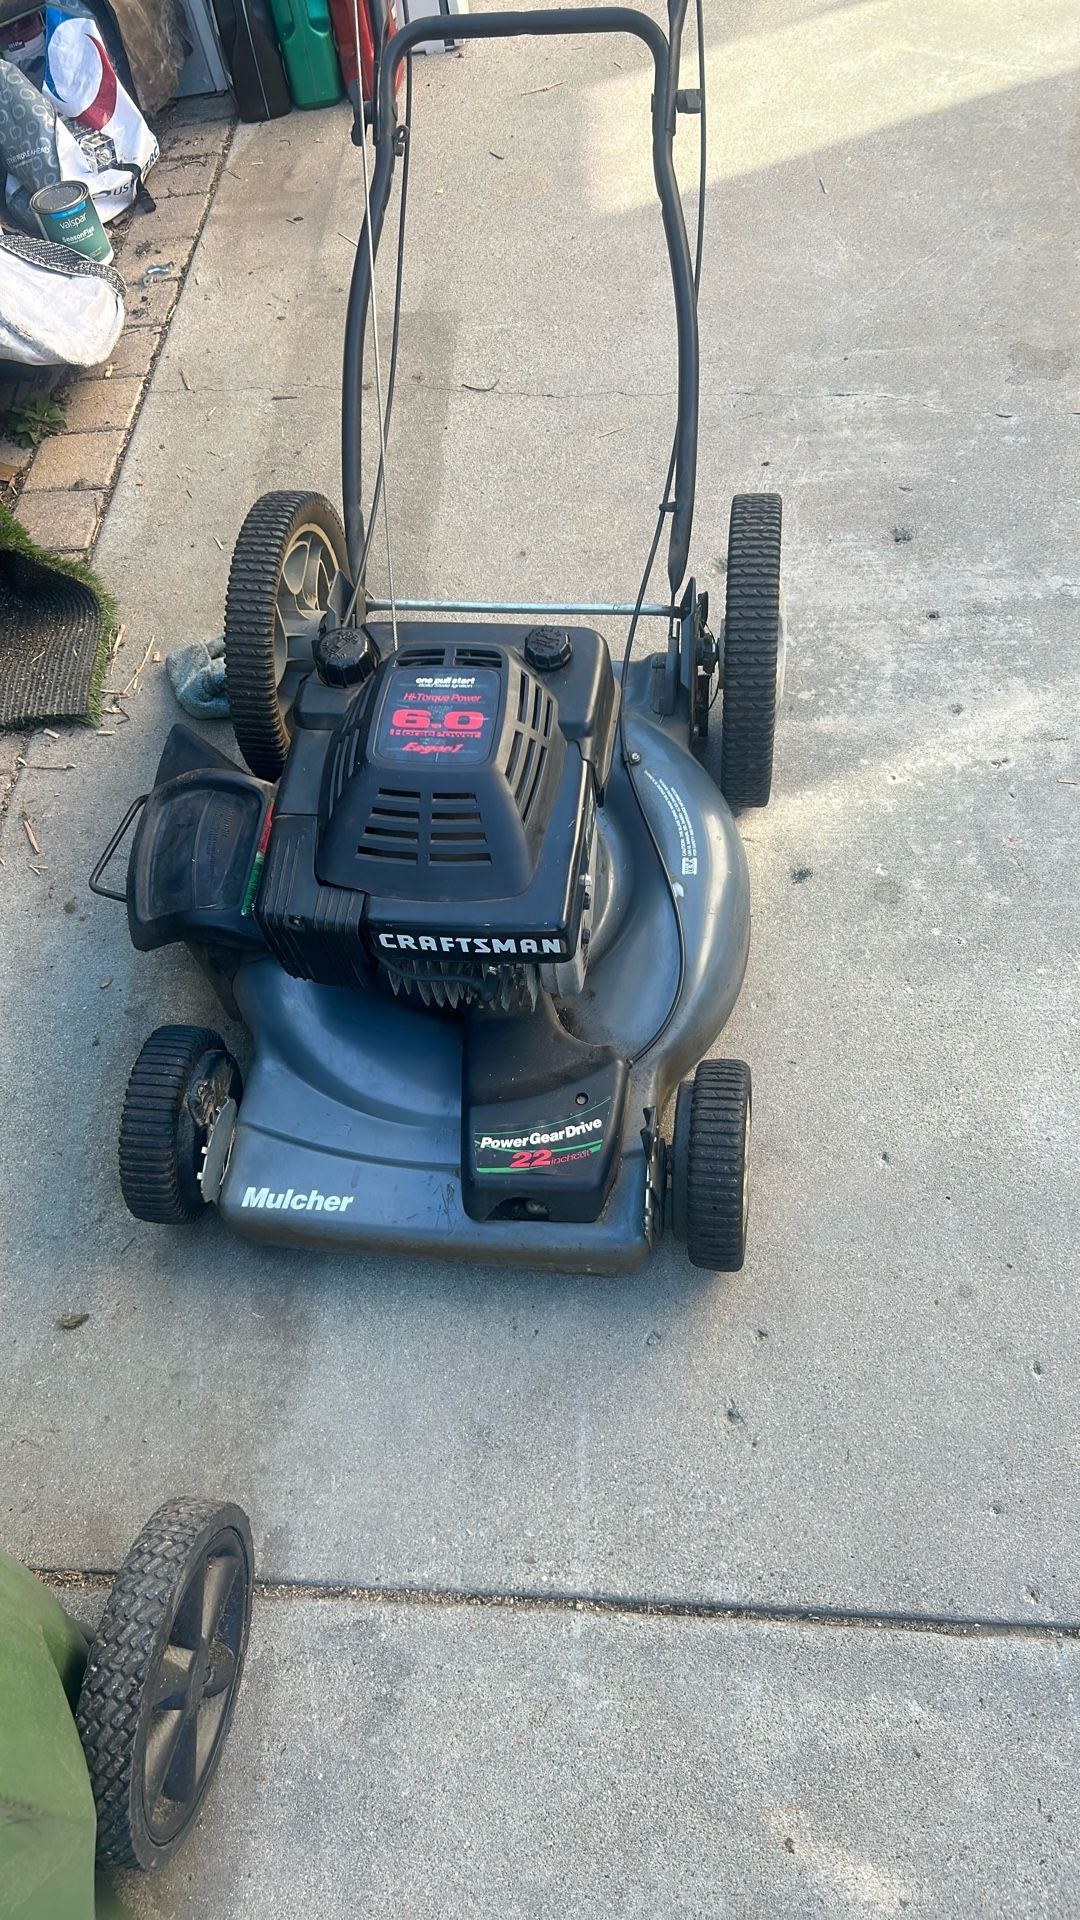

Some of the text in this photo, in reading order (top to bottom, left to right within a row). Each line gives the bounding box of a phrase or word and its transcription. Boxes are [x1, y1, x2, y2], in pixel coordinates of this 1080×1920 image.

[60, 212, 87, 230] valspar
[62, 225, 95, 243] SeasonFlex
[433, 676, 452, 686] pull
[451, 677, 476, 685] start
[403, 692, 481, 703] Hi-Torque Power
[392, 709, 484, 730] 6.0
[378, 933, 562, 954] CRAFTSMAN
[508, 1149, 553, 1168] 22
[241, 1186, 354, 1212] Mulcher
